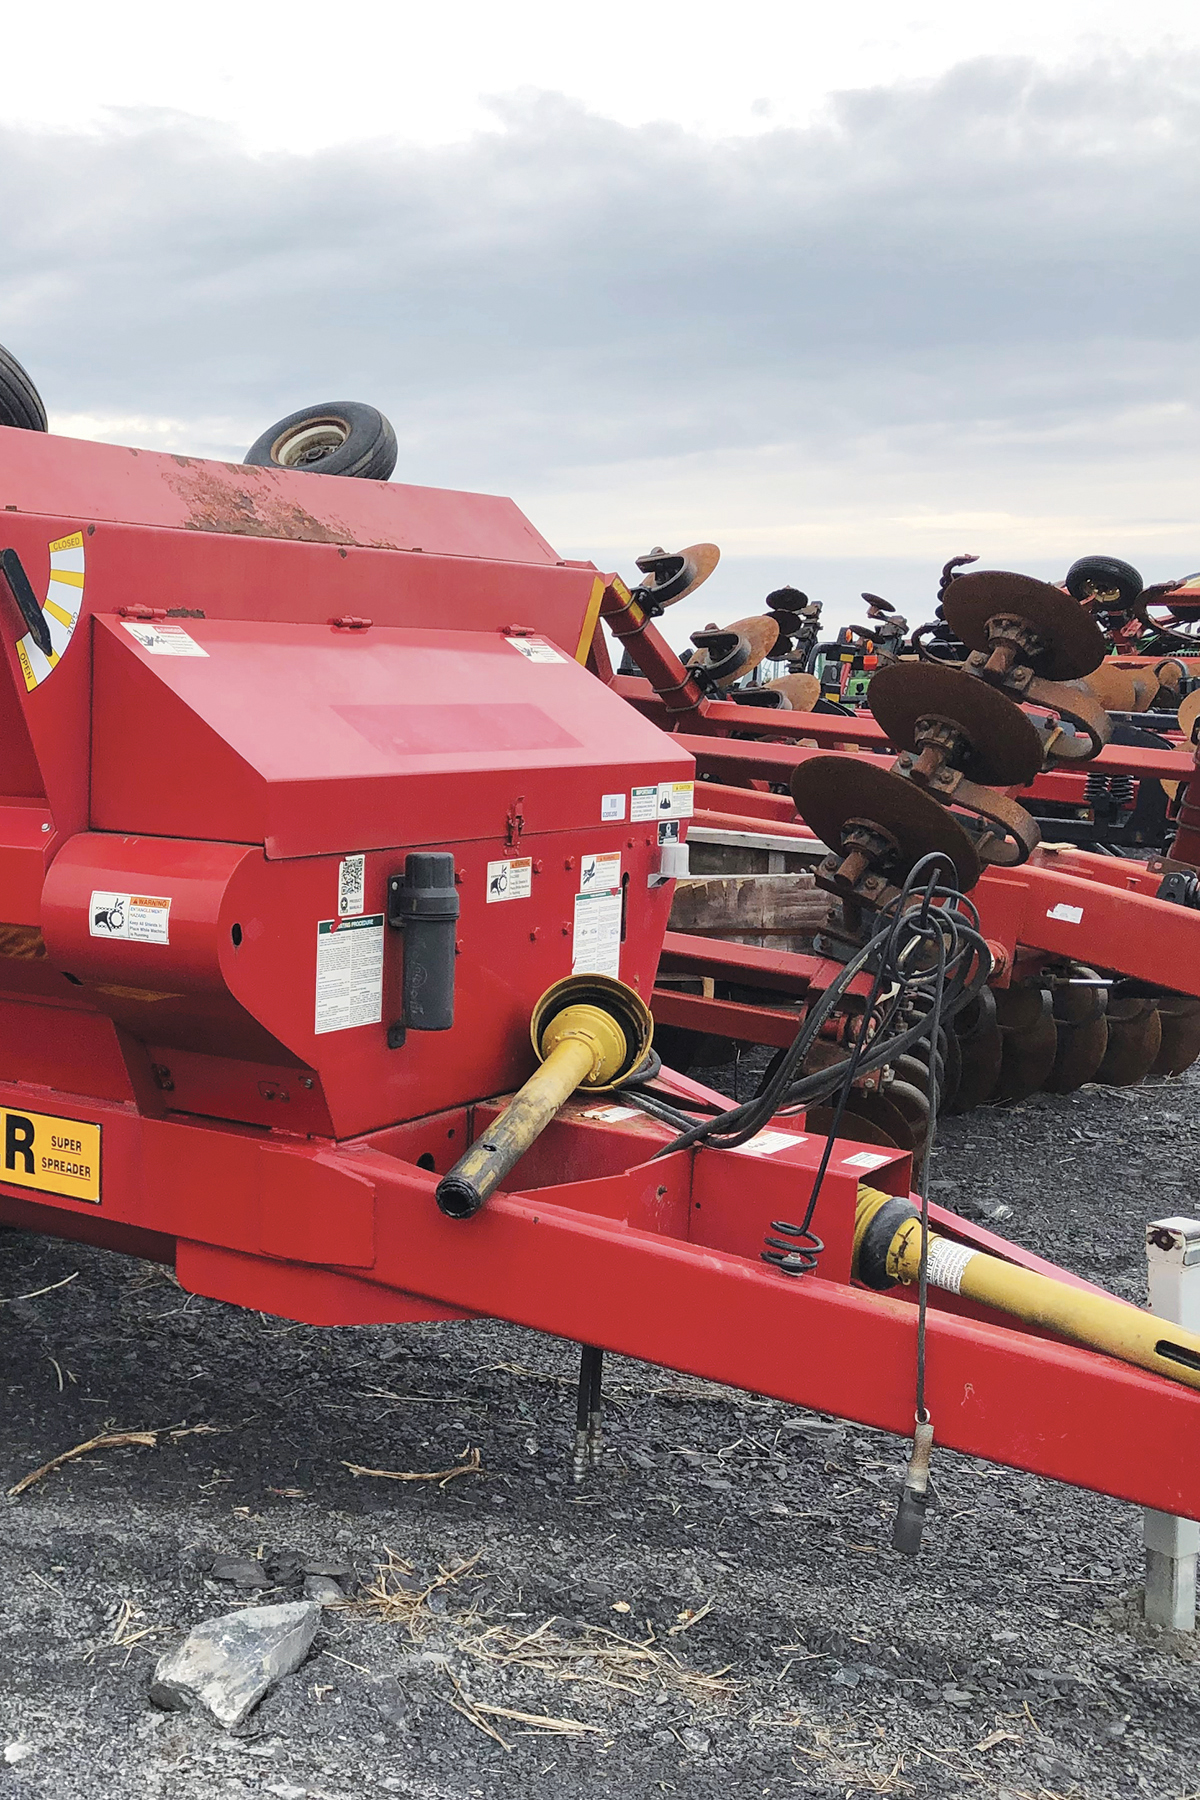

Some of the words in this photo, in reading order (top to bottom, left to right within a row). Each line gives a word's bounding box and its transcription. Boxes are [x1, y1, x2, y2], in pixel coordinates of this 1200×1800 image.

[53, 537, 80, 551] CLOSED
[66, 611, 78, 636] GATE
[19, 653, 33, 680] OPEN
[139, 899, 167, 907] WARNING
[51, 1136, 82, 1153] SUPER
[42, 1157, 91, 1178] SPREADER
